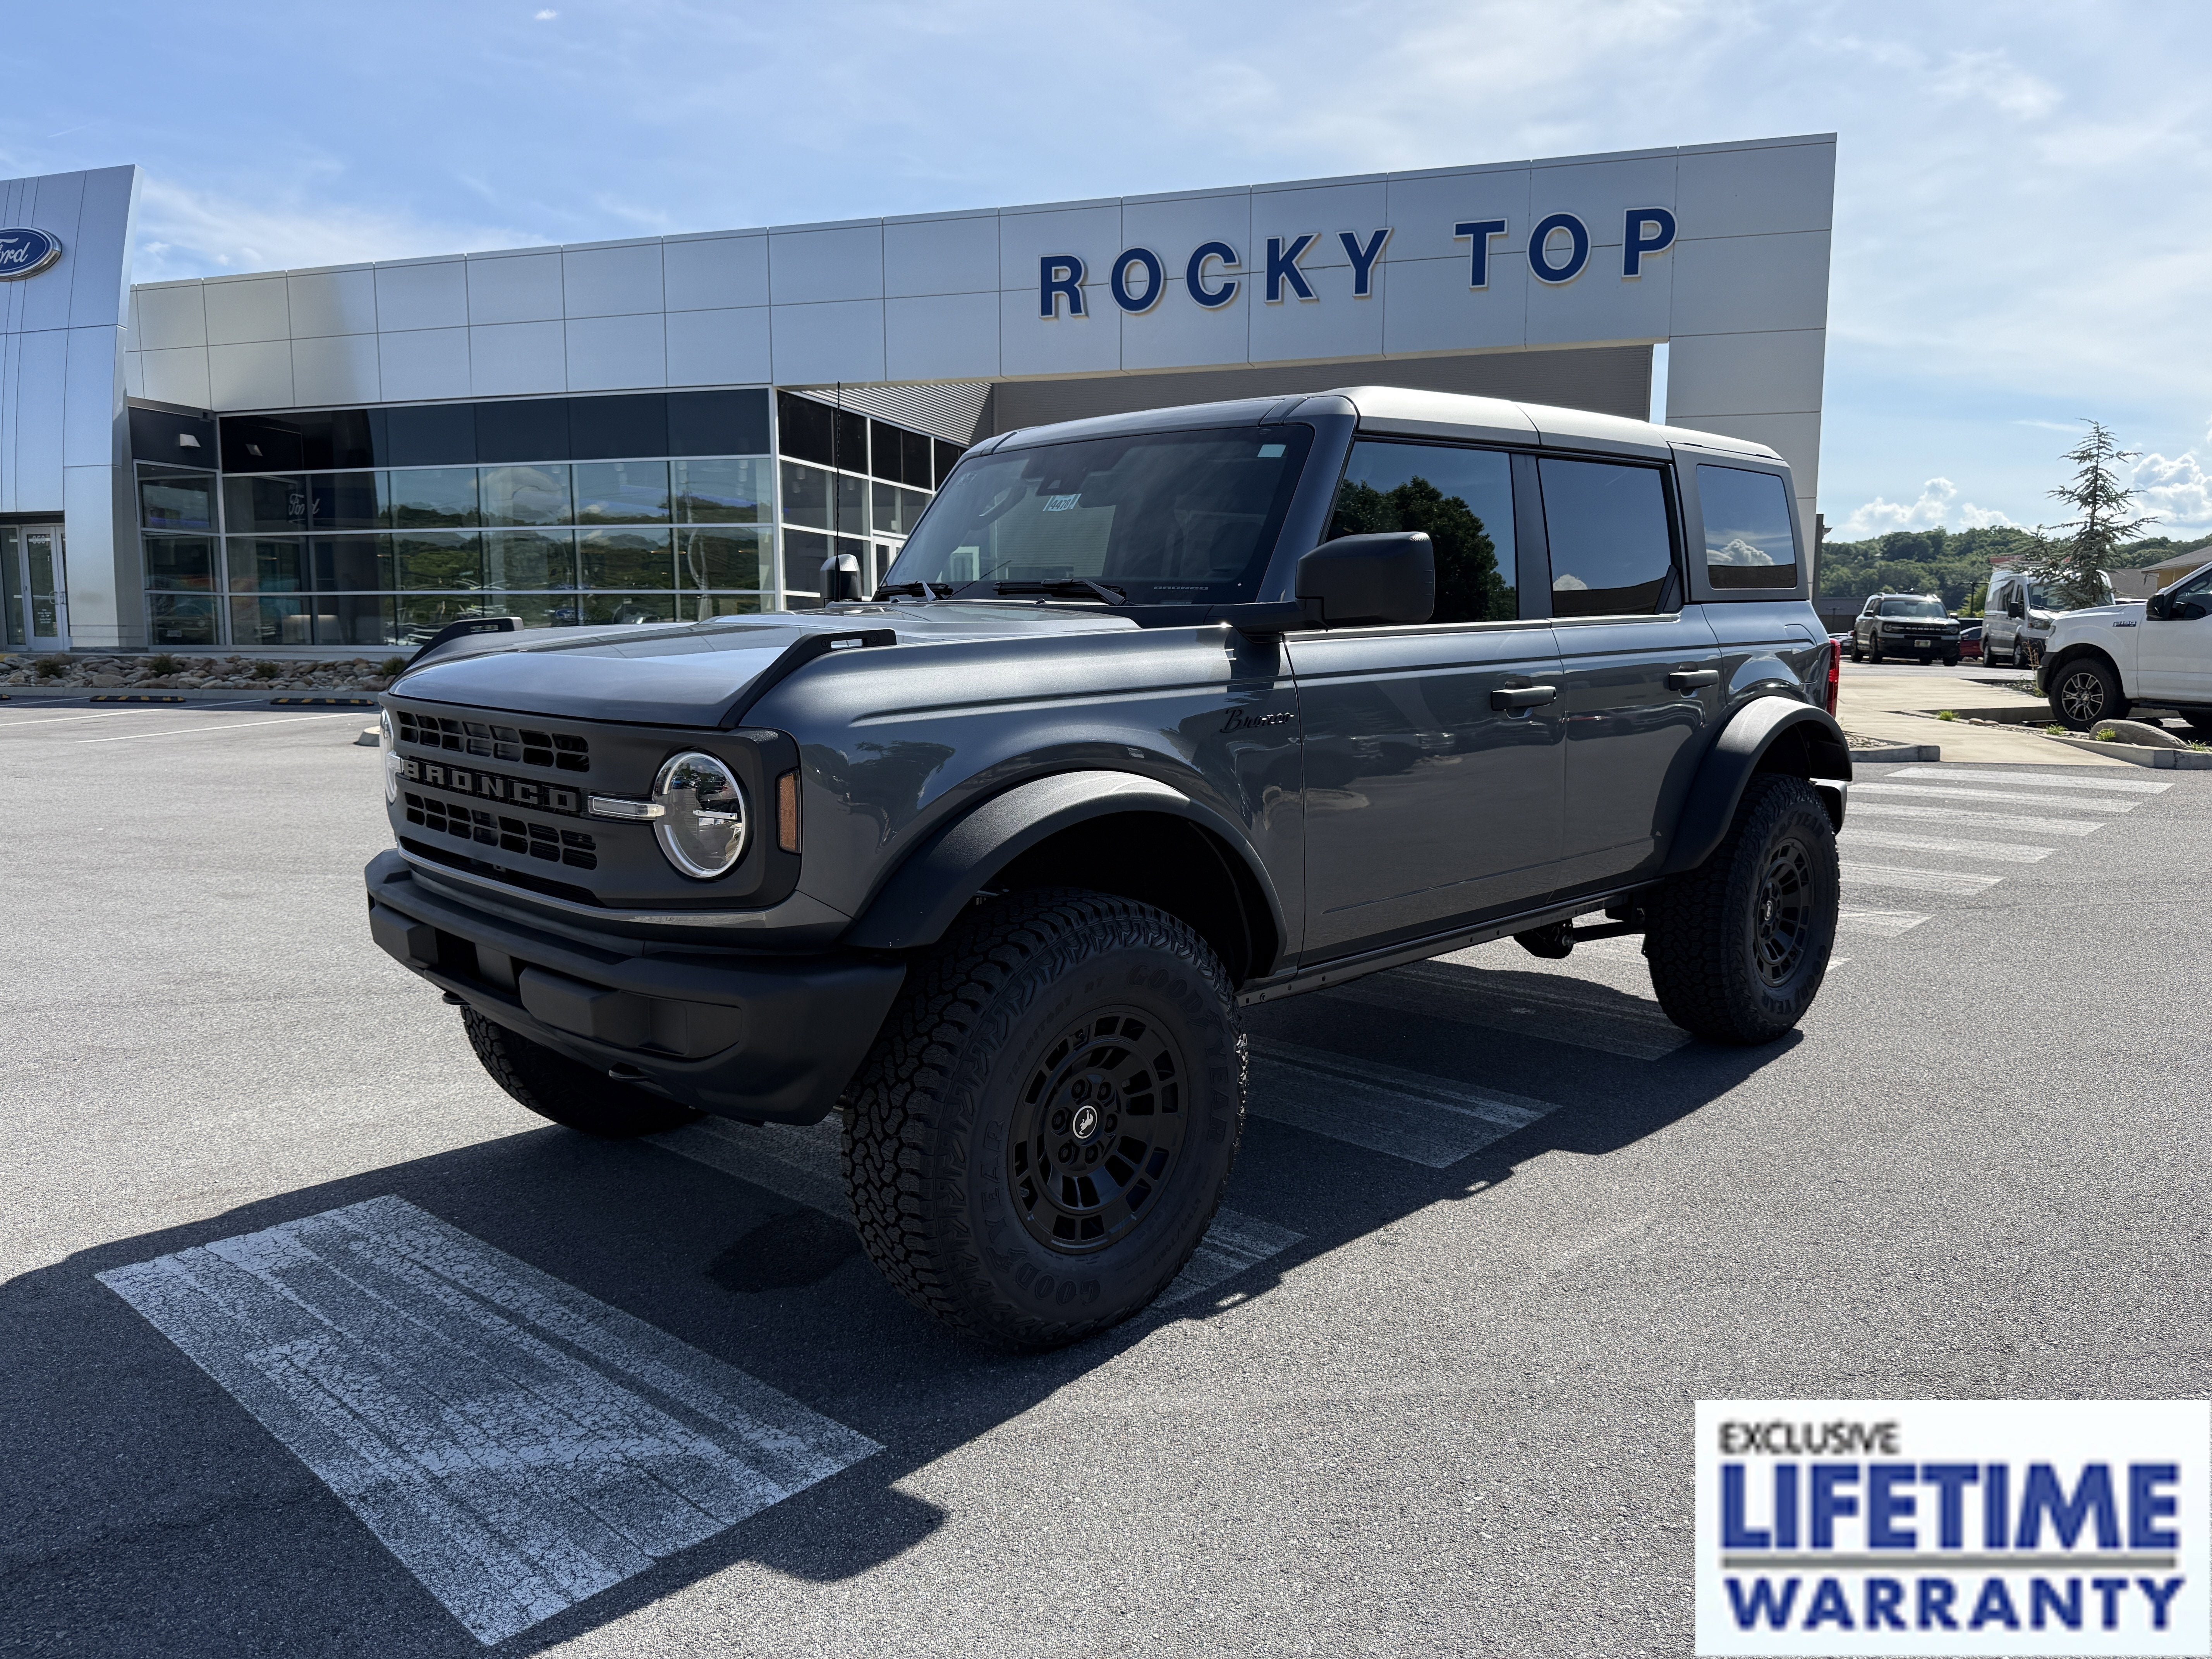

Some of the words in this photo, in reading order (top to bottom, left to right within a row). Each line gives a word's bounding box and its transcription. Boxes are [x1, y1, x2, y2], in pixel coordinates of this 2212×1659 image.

[1038, 226, 1393, 319] ROCKY
[1453, 206, 1678, 289] TOP
[1050, 499, 1071, 509] 4478
[1219, 709, 1294, 733] Bronco
[403, 759, 578, 812] BRONCO
